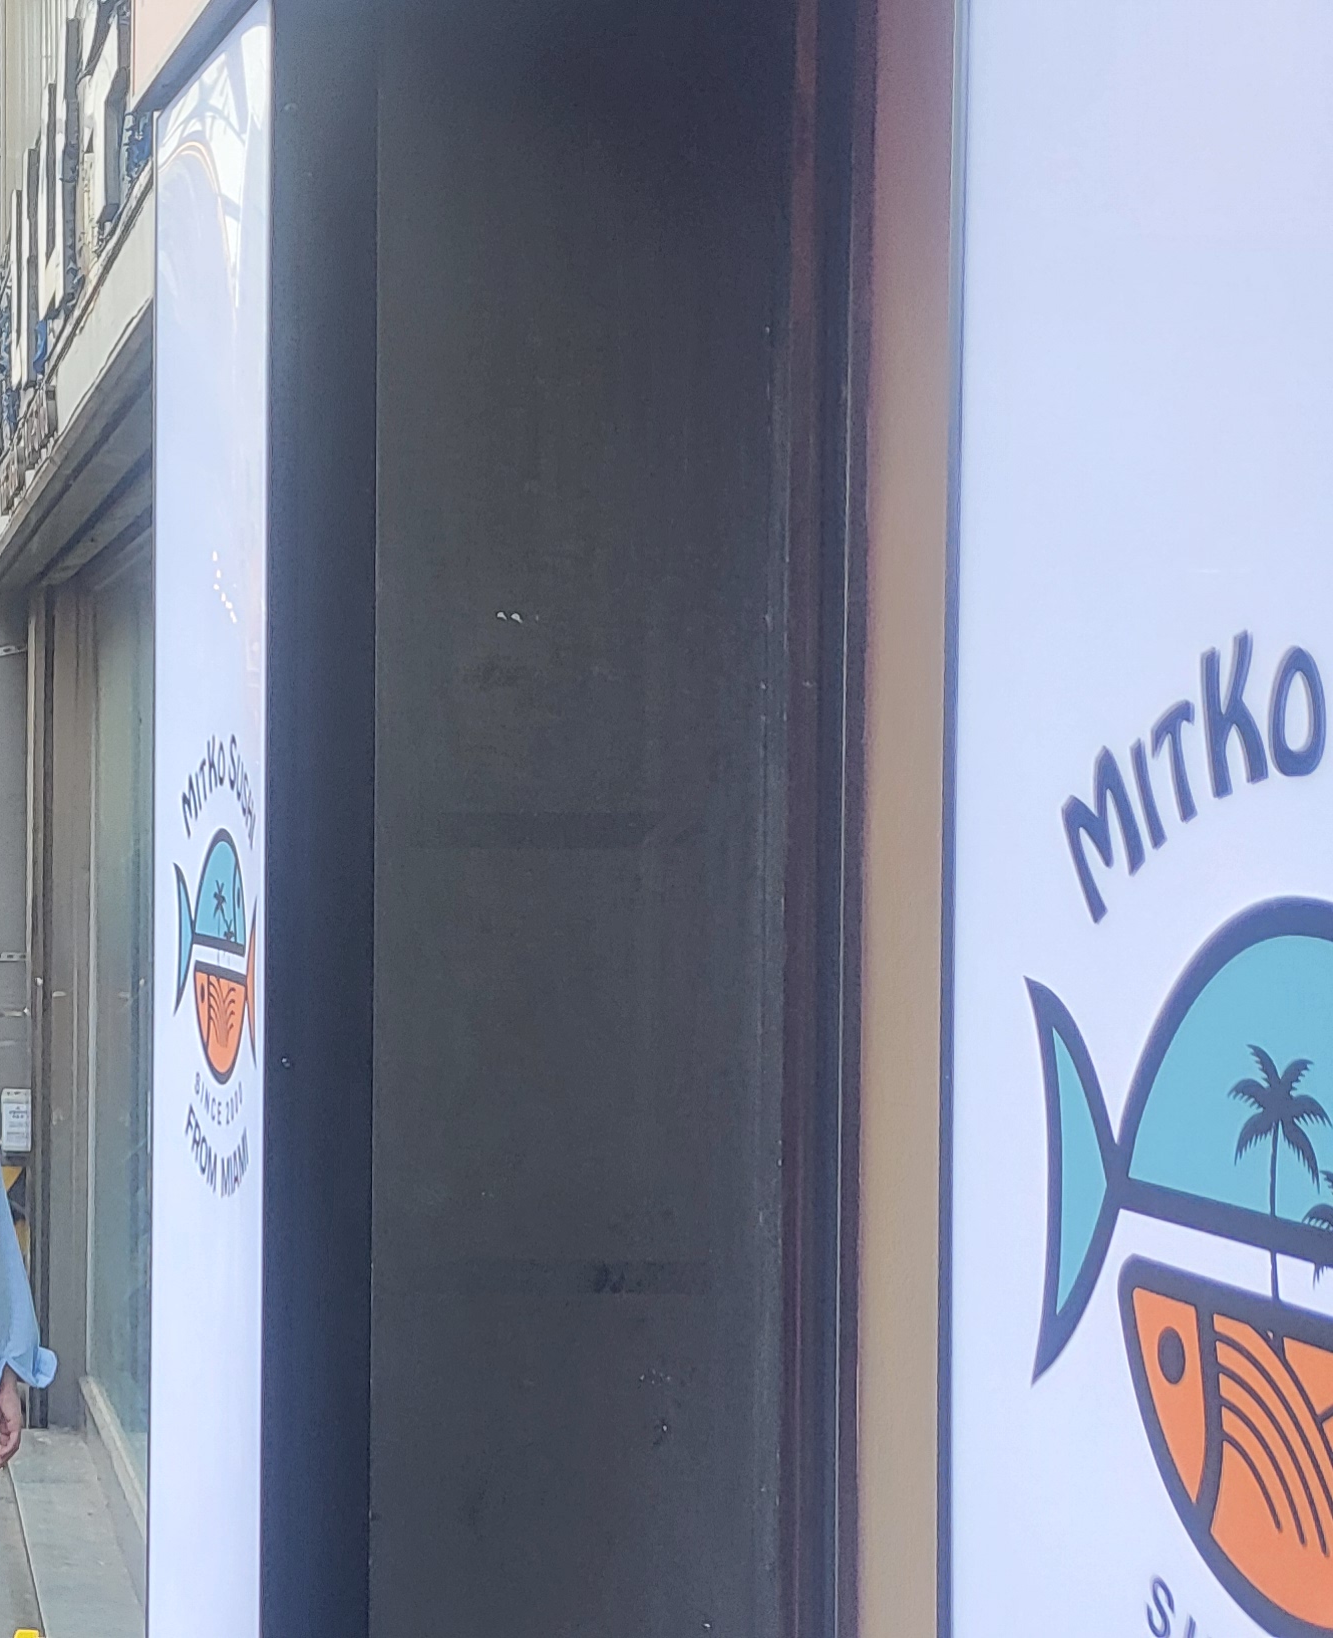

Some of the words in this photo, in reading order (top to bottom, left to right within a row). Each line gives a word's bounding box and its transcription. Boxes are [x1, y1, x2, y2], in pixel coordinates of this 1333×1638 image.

[181, 733, 226, 839] MITKO
[228, 733, 256, 851] SUSHI
[1061, 629, 1327, 924] MITKO
[185, 1102, 218, 1193] FROM
[220, 1126, 249, 1199] MIAMI
[194, 1071, 222, 1126] SINCE
